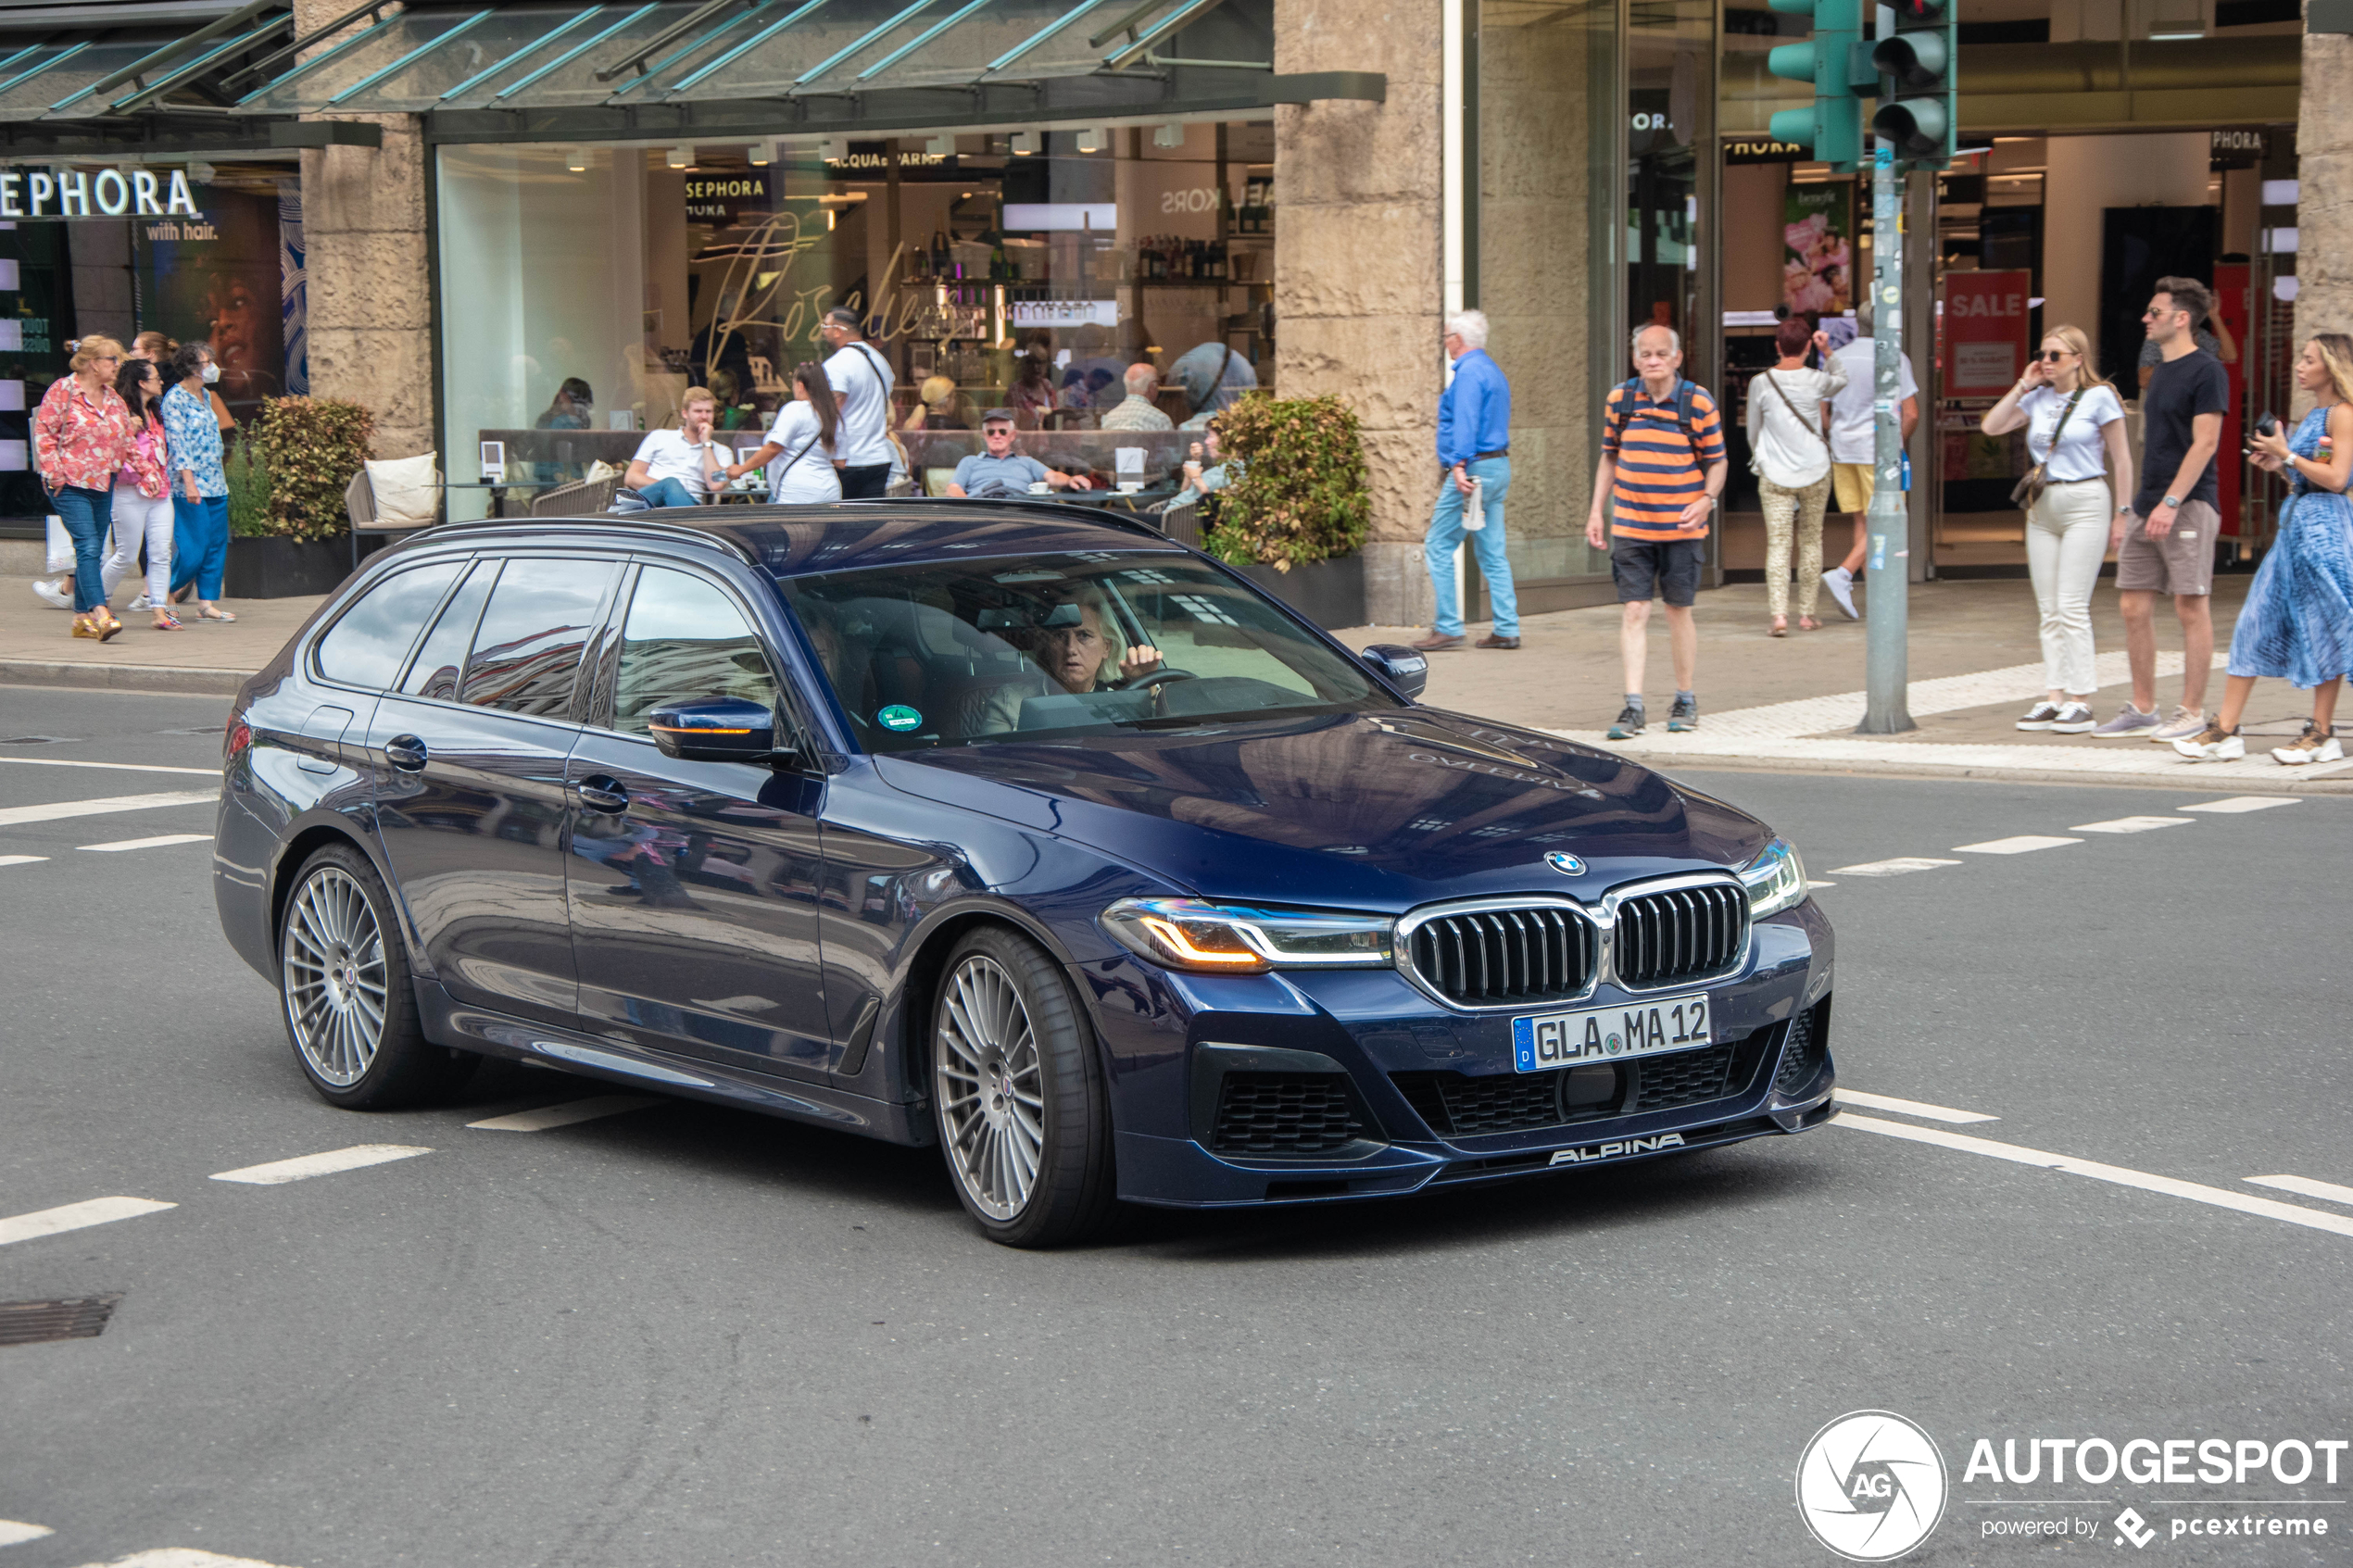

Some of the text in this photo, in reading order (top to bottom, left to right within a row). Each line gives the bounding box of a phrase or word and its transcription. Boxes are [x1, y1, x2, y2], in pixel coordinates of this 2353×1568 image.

[0, 169, 198, 216] EPHORA
[686, 180, 764, 198] SEPHORA
[145, 221, 219, 240] with hair.
[1952, 294, 2021, 317] SALE
[894, 709, 905, 719] 4
[1537, 1001, 1707, 1061] GLA MA 12
[1521, 1050, 1529, 1062] D
[1549, 1133, 1686, 1166] ALPINA
